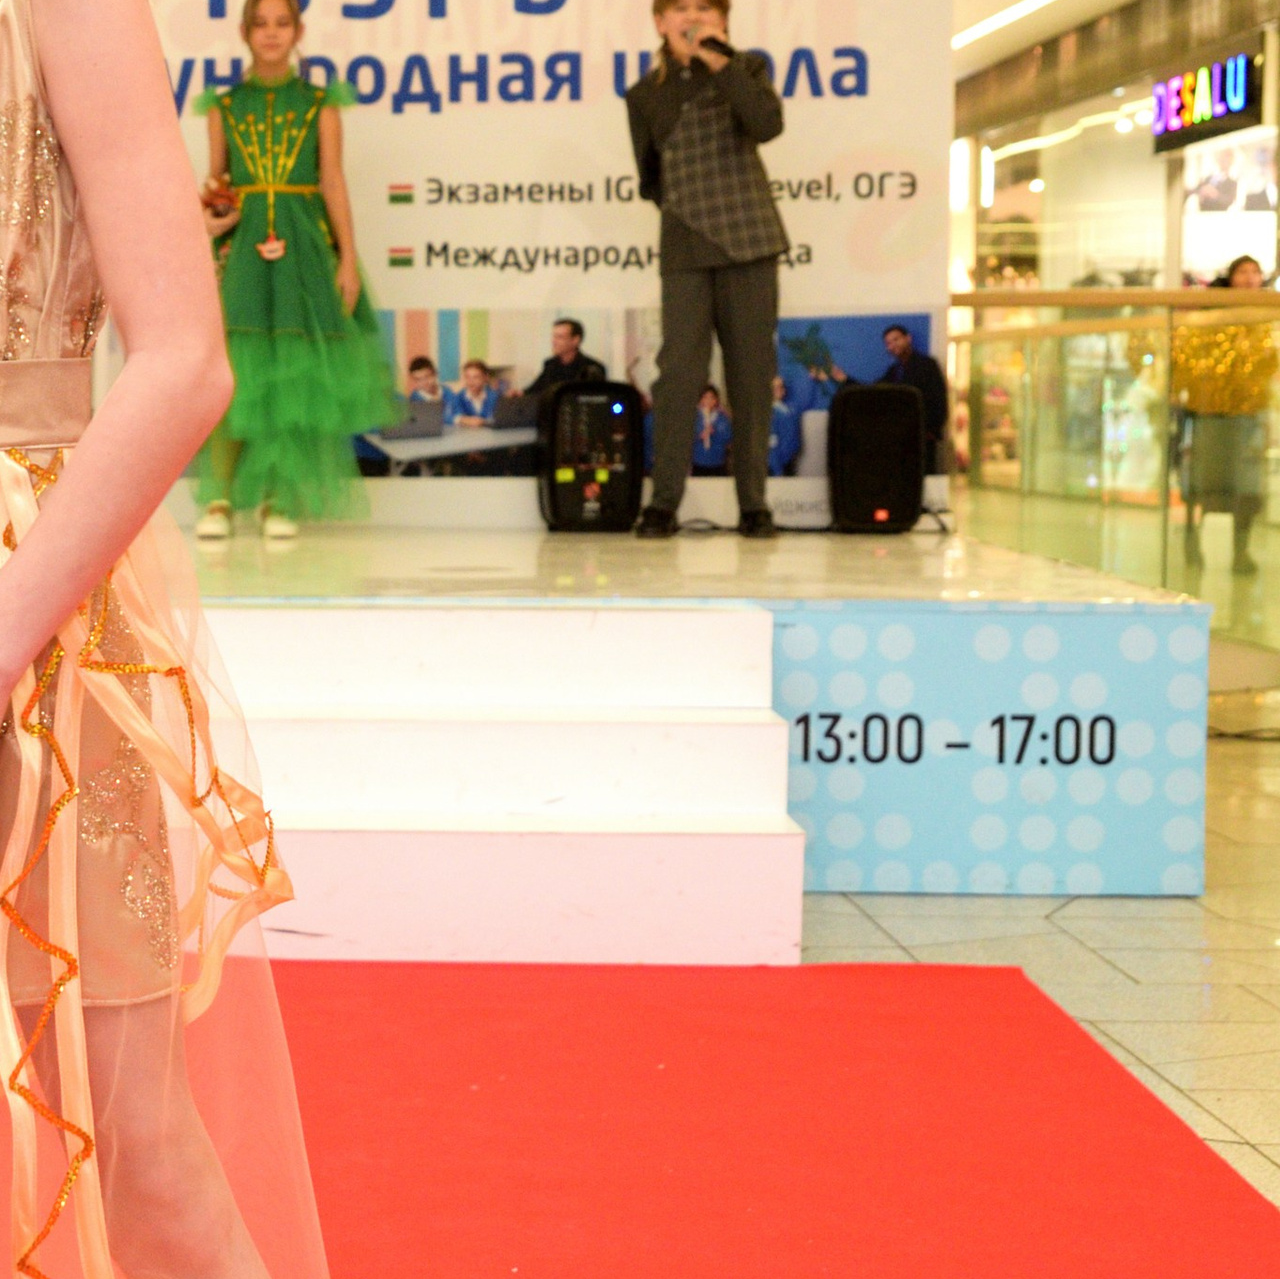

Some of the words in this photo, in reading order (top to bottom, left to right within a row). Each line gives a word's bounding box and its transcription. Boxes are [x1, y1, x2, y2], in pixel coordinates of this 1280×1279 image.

[1151, 52, 1248, 136] DESALU
[425, 177, 594, 205] Экзамены
[769, 172, 841, 203] evel,
[853, 171, 918, 199] ОГЭ
[425, 241, 662, 272] Международн
[793, 712, 925, 764] 13:00
[990, 713, 1118, 766] 17:00
